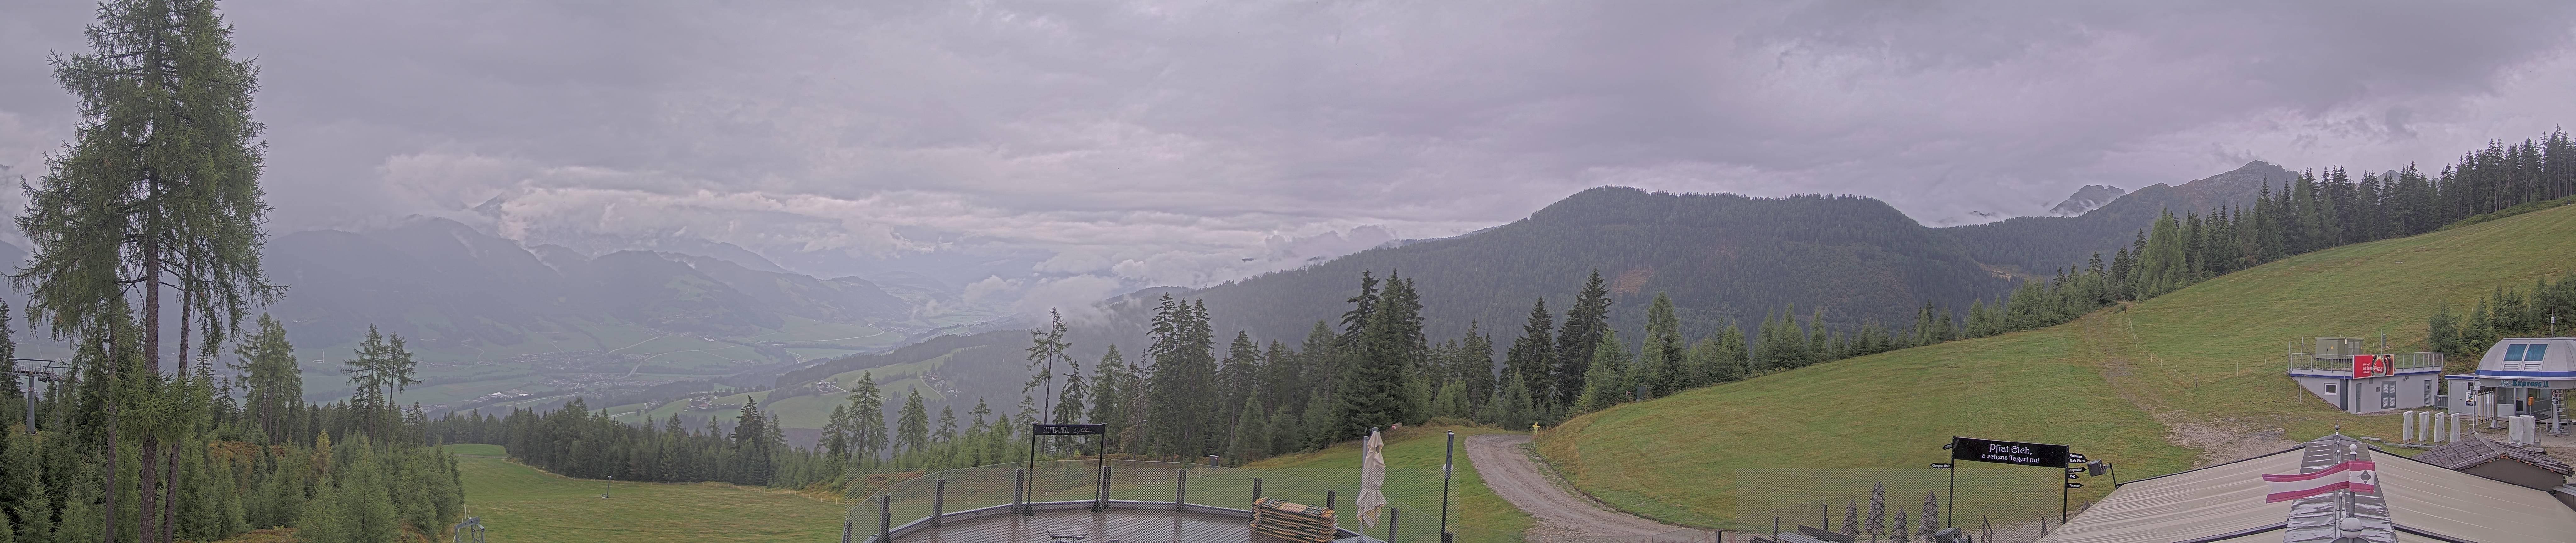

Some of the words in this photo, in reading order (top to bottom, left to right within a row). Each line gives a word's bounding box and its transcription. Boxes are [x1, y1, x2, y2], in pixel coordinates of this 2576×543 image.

[2512, 380, 2542, 388] Express
[1989, 444, 2009, 453] Pfiat
[2011, 446, 2032, 455] Eich,
